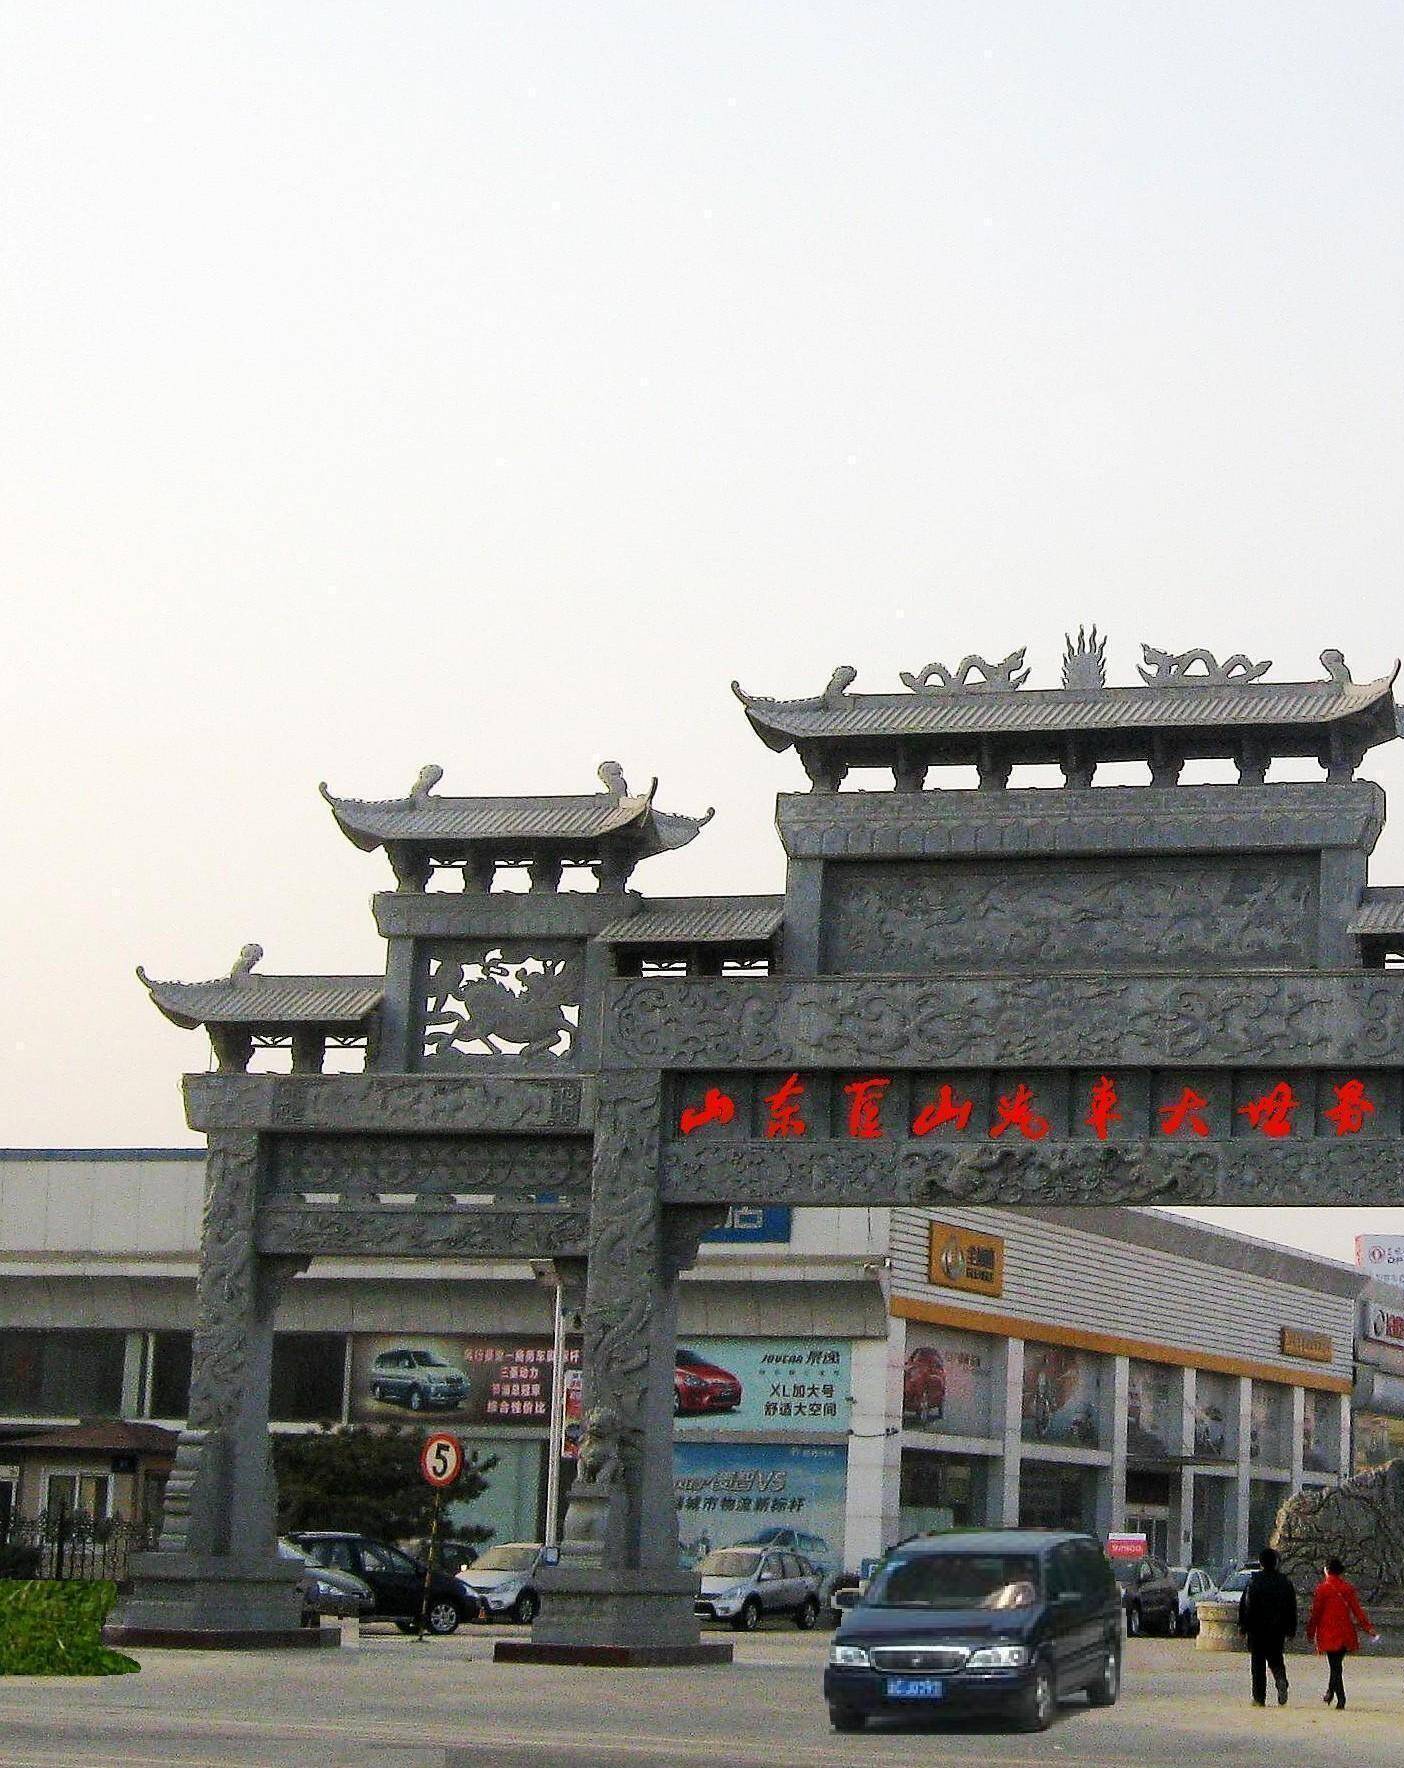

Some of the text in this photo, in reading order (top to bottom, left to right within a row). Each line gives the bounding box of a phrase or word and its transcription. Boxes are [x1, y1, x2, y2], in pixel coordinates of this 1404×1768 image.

[769, 1383, 834, 1398] XL加大号
[764, 1401, 837, 1417] 舒适大空间
[432, 1442, 450, 1478] 5
